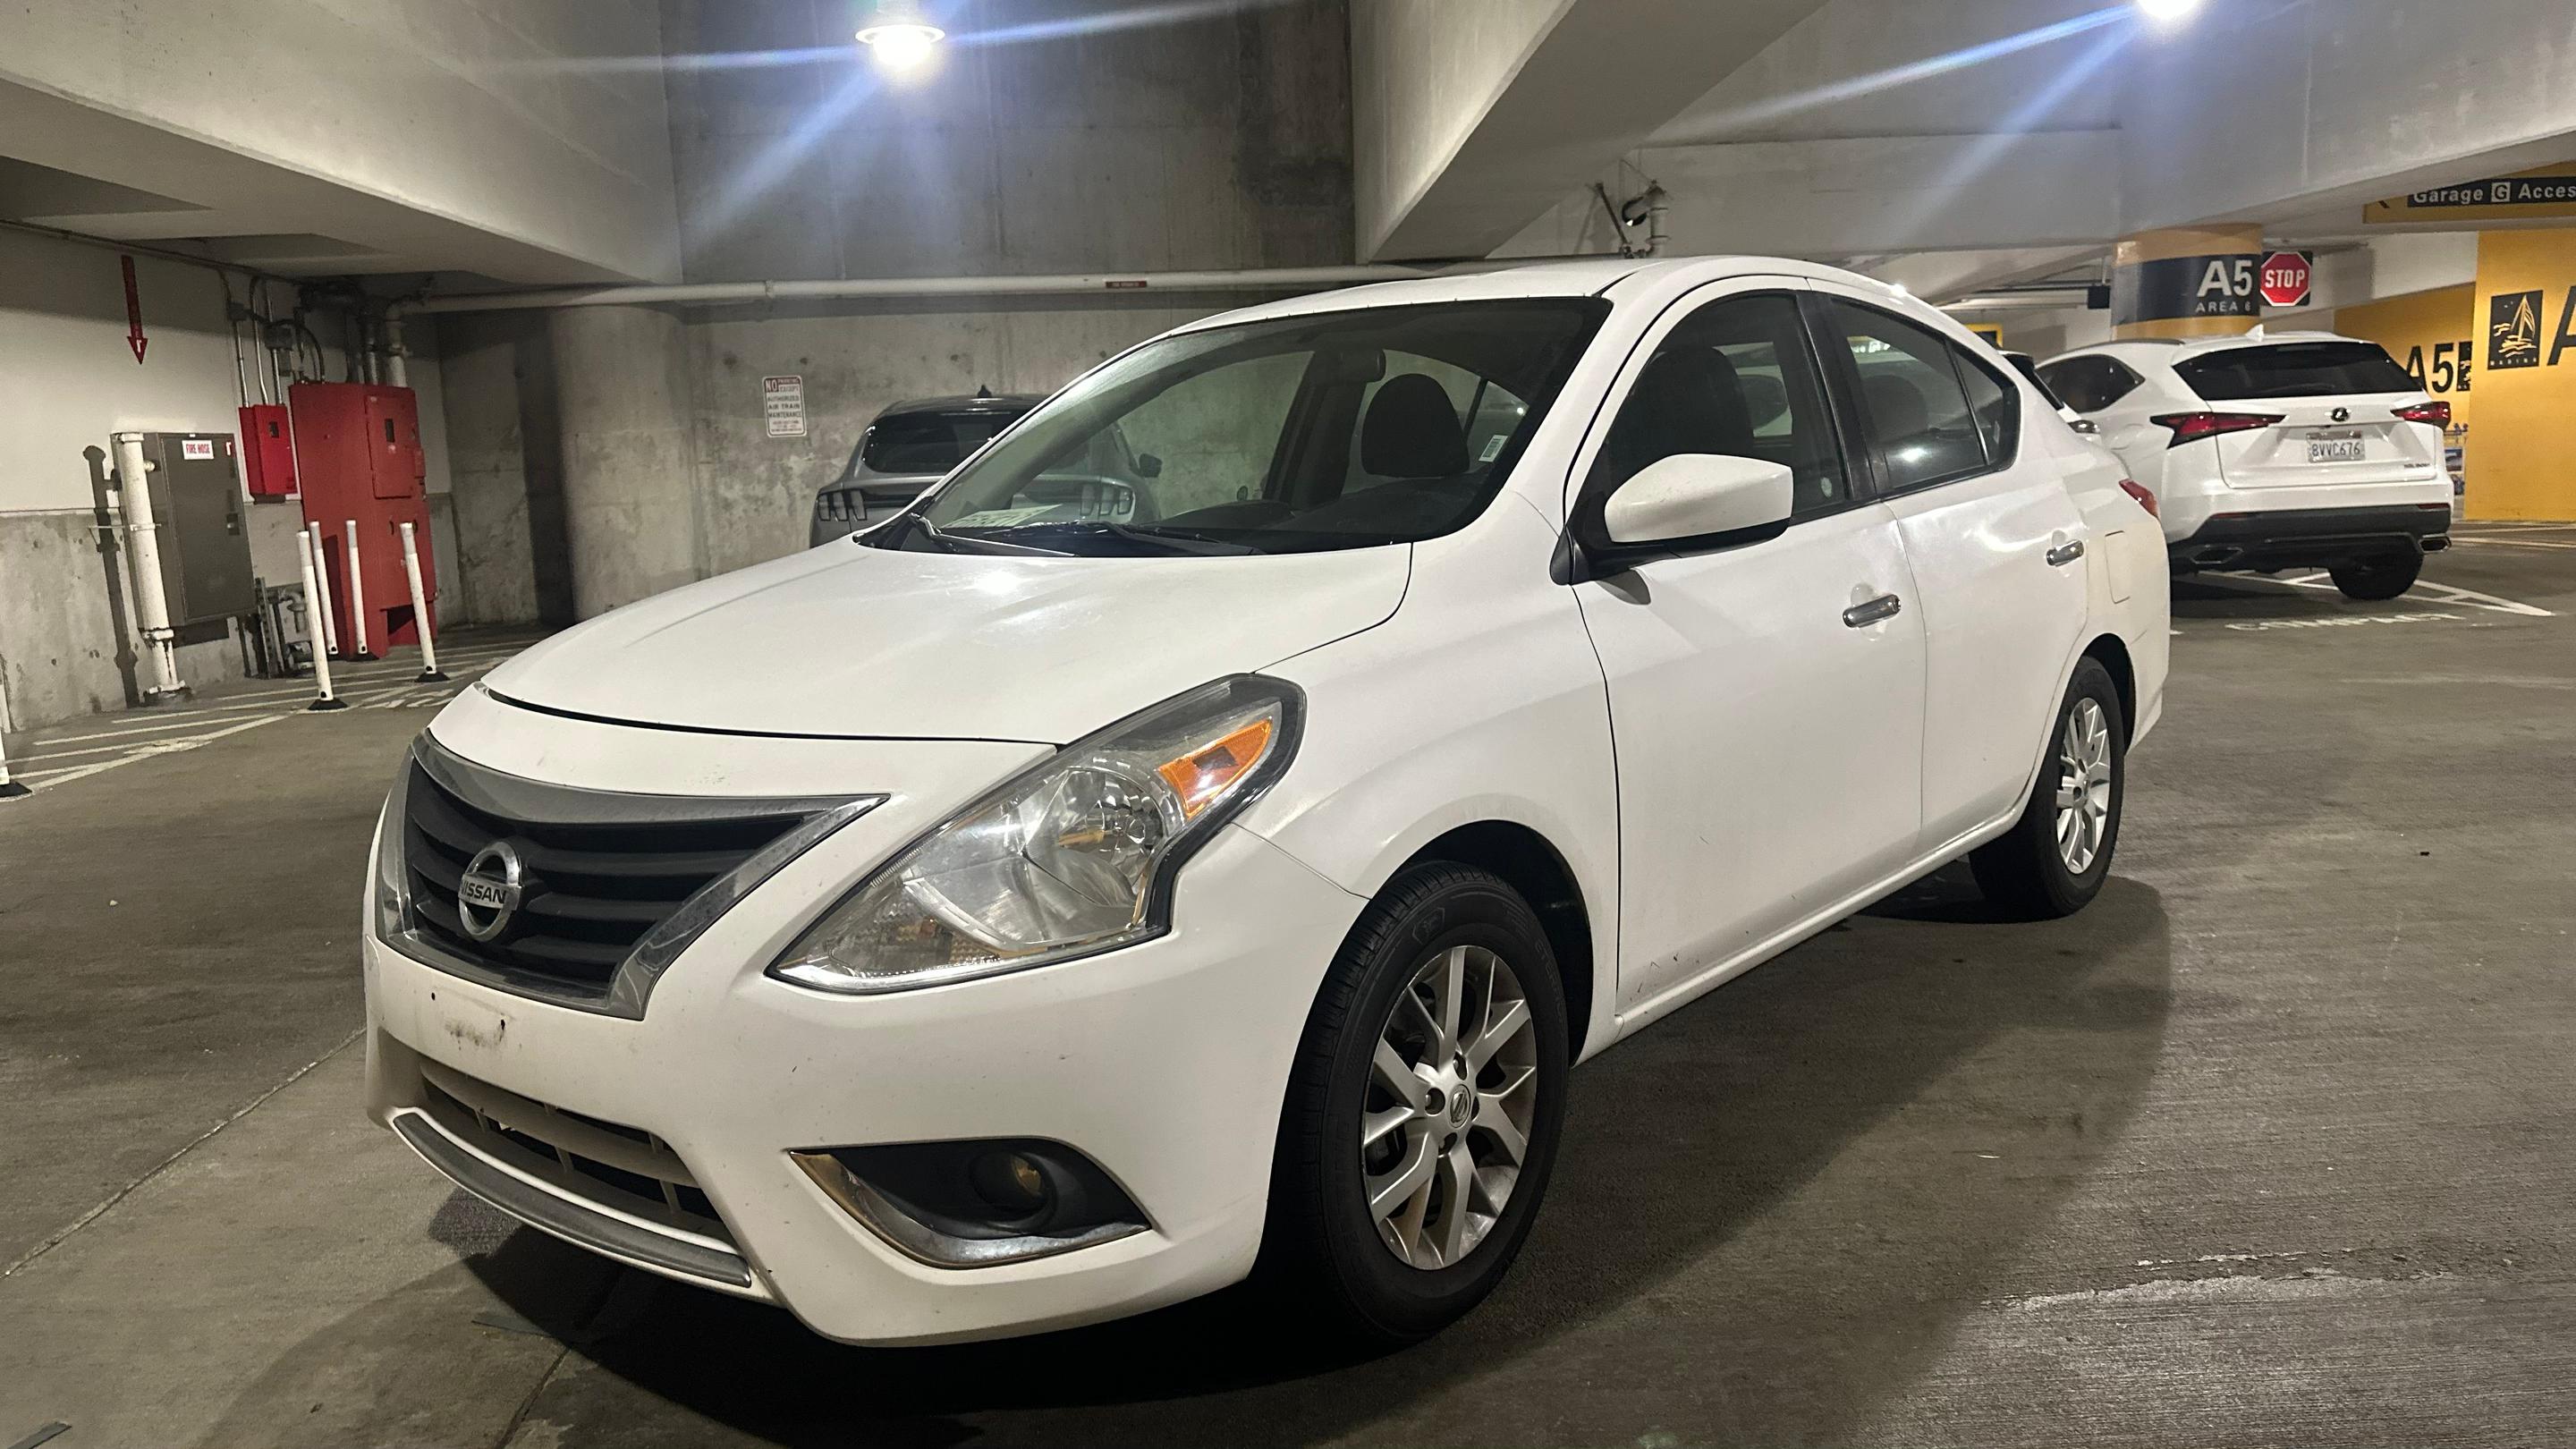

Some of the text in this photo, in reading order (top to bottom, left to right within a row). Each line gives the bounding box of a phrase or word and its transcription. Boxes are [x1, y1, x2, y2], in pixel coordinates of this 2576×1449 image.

[2414, 188, 2484, 205] Garage
[2495, 183, 2510, 201] G
[2197, 259, 2252, 297] A5
[2265, 269, 2305, 288] STOP
[2196, 301, 2238, 313] AREA
[2406, 343, 2454, 393] A5
[766, 378, 778, 392] NO
[186, 444, 210, 453] FIRE HOSE
[461, 879, 506, 904] NISSAN
